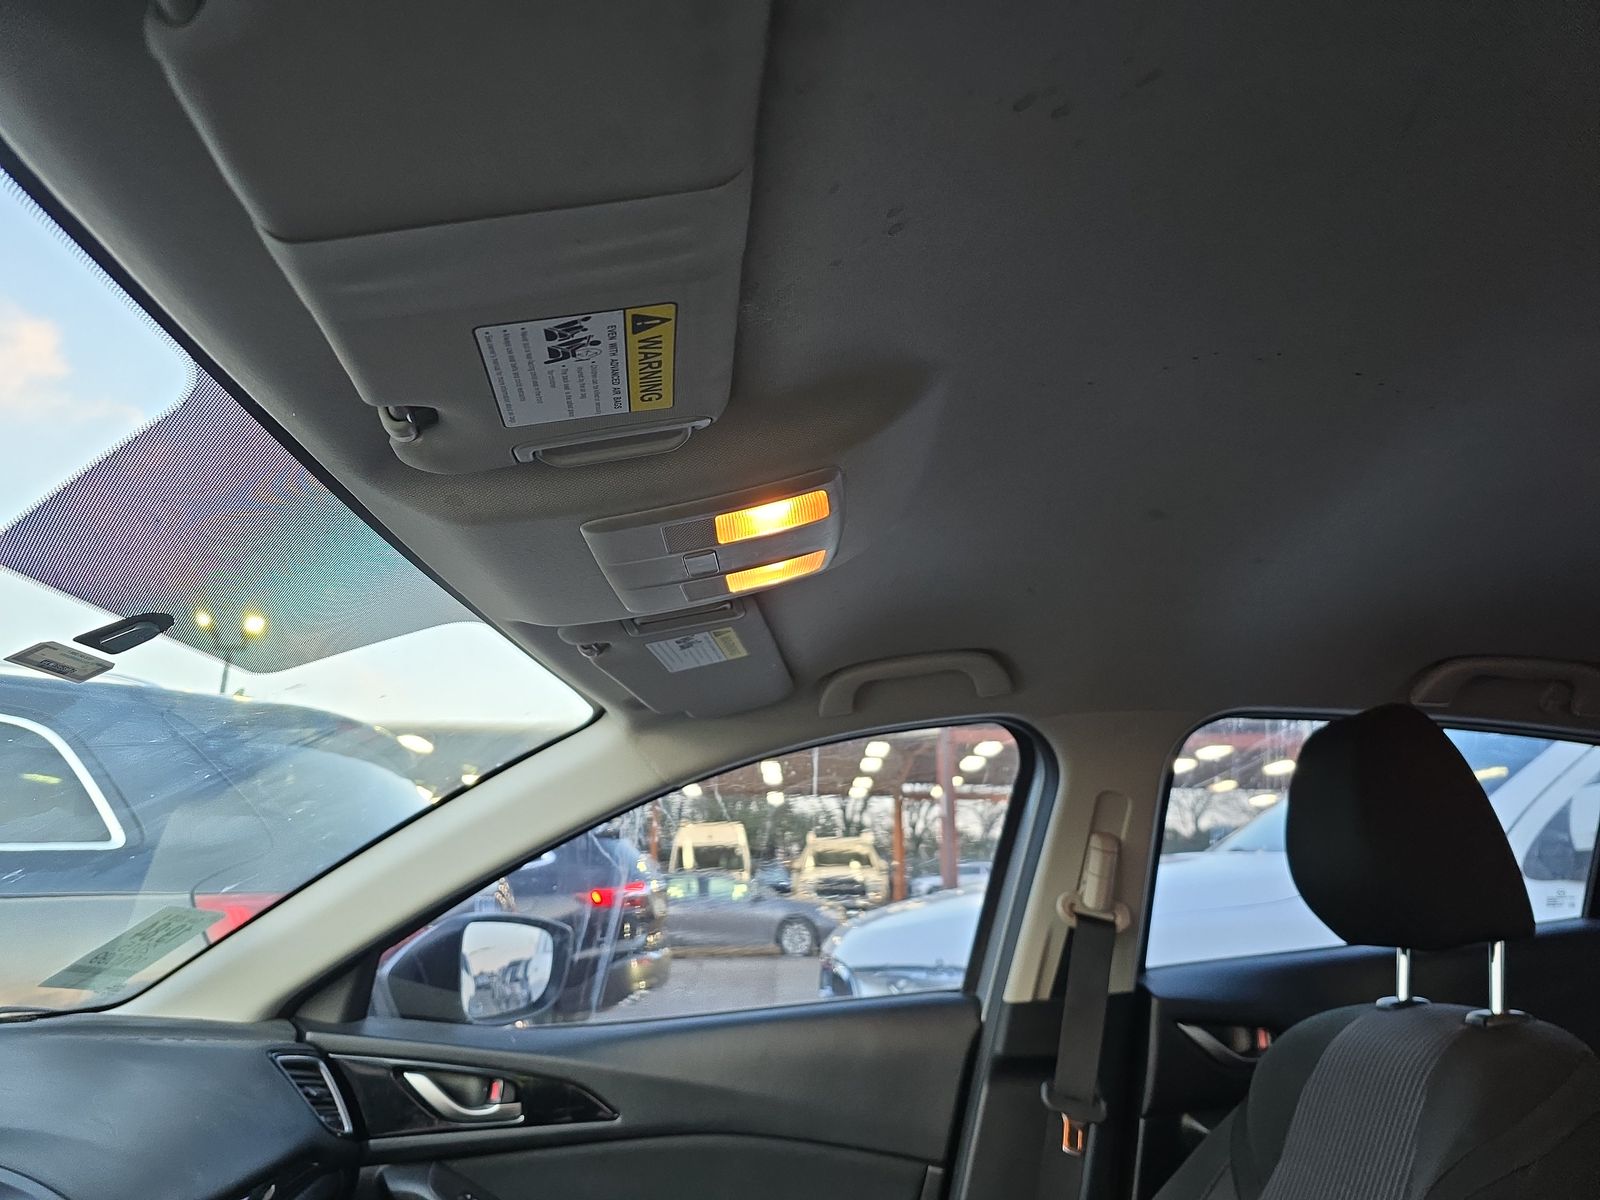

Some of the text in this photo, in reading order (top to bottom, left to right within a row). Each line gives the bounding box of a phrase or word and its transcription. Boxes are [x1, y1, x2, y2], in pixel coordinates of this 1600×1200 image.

[606, 325, 623, 410] EVEN WITH ADVANCED AIR BAGS
[637, 334, 664, 403] WARNING
